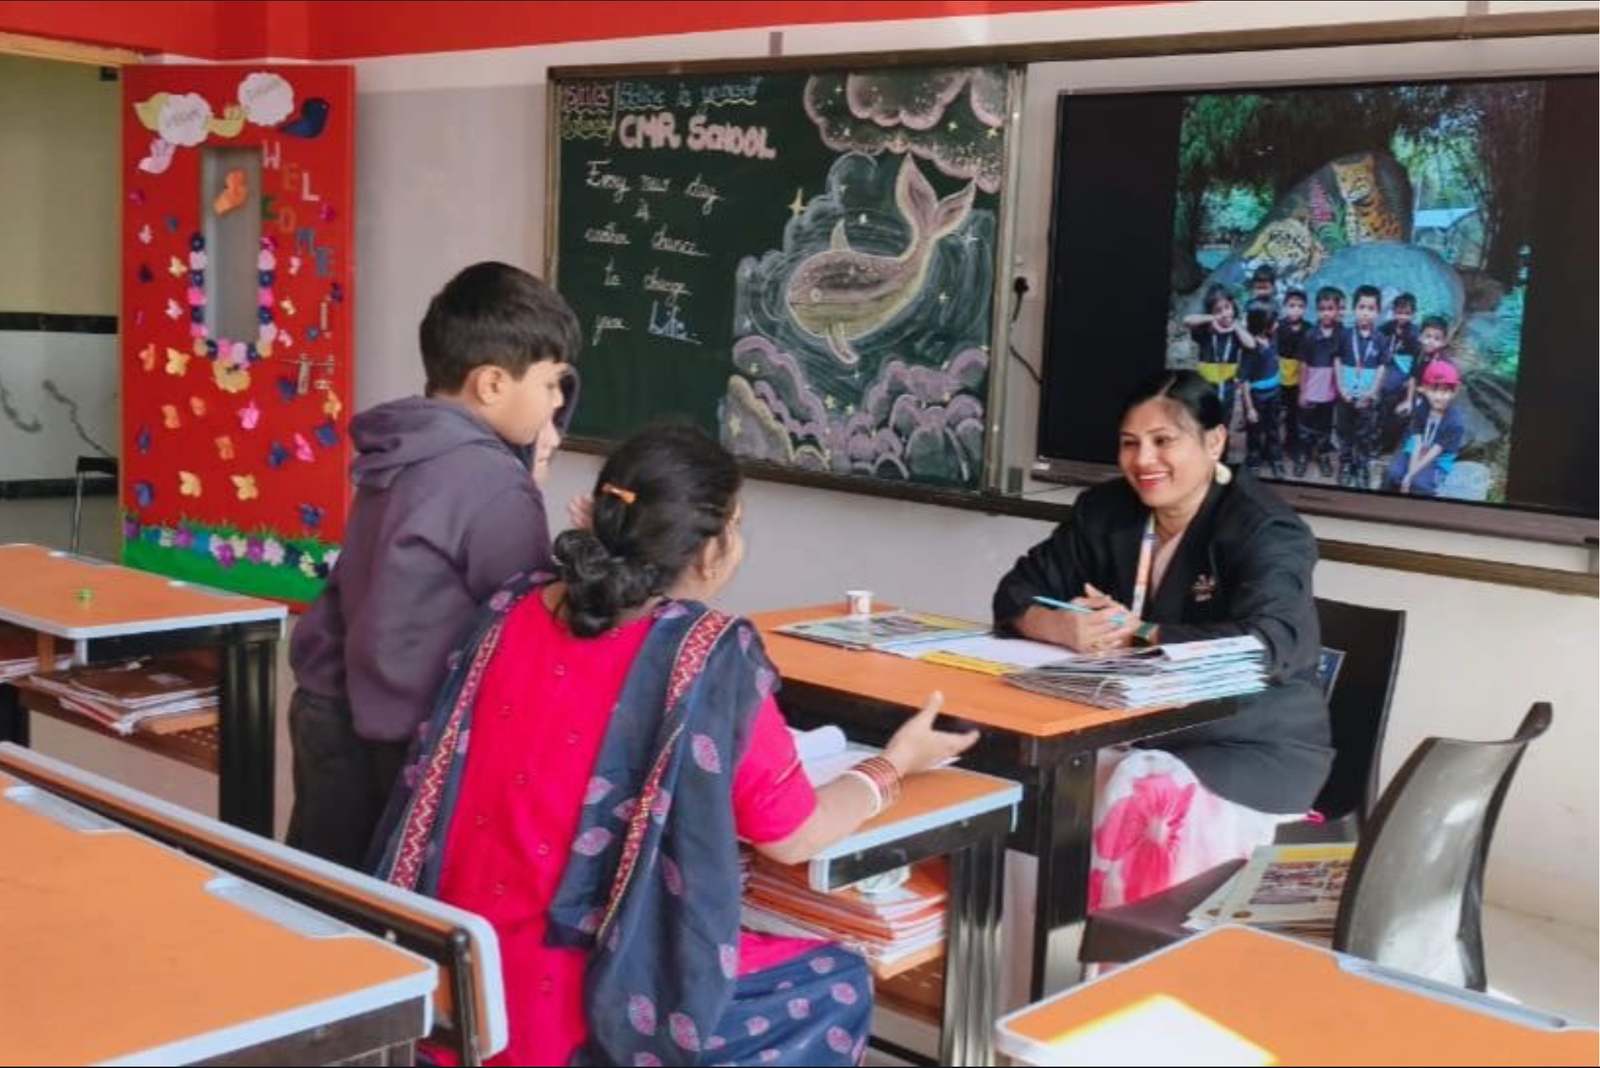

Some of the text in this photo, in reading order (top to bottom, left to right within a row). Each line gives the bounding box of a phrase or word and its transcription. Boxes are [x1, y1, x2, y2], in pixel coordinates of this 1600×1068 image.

[618, 111, 681, 148] CMR
[585, 160, 724, 215] Every new day
[634, 198, 650, 221] is
[651, 223, 709, 257] chance
[604, 256, 693, 307] to change
